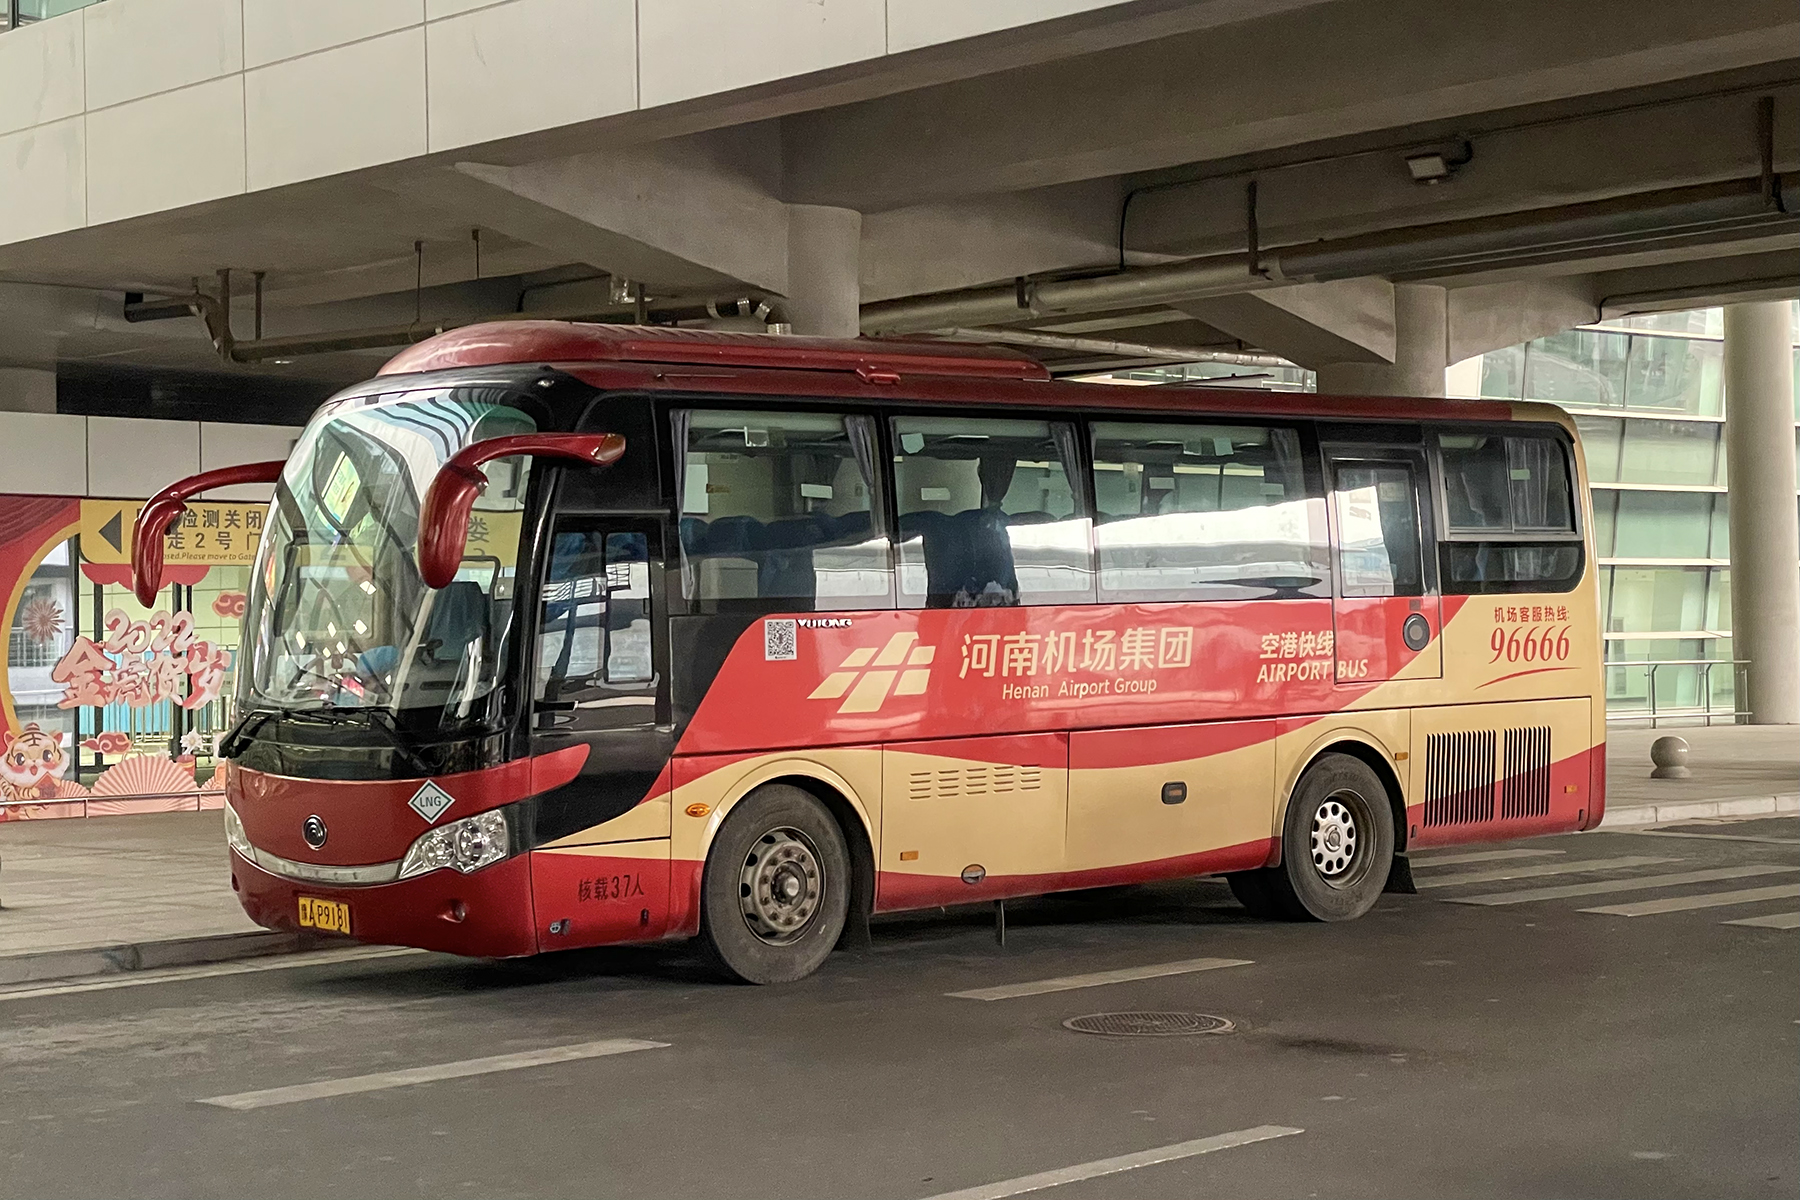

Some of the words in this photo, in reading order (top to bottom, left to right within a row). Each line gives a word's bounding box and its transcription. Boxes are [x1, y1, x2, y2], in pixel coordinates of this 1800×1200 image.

[136, 509, 262, 529] 检测关闭
[105, 608, 195, 653] 2022
[1488, 625, 1572, 664] 96666
[959, 626, 1194, 680] 河南机场集团
[1260, 631, 1335, 659] 空港快线
[1257, 661, 1332, 683] AIRPORT
[1337, 659, 1368, 679] BUS
[1002, 683, 1049, 699] Henan
[1058, 679, 1109, 699] Airport
[1113, 678, 1157, 696] Group
[419, 796, 441, 809] LNG
[578, 873, 645, 902] 核载37人
